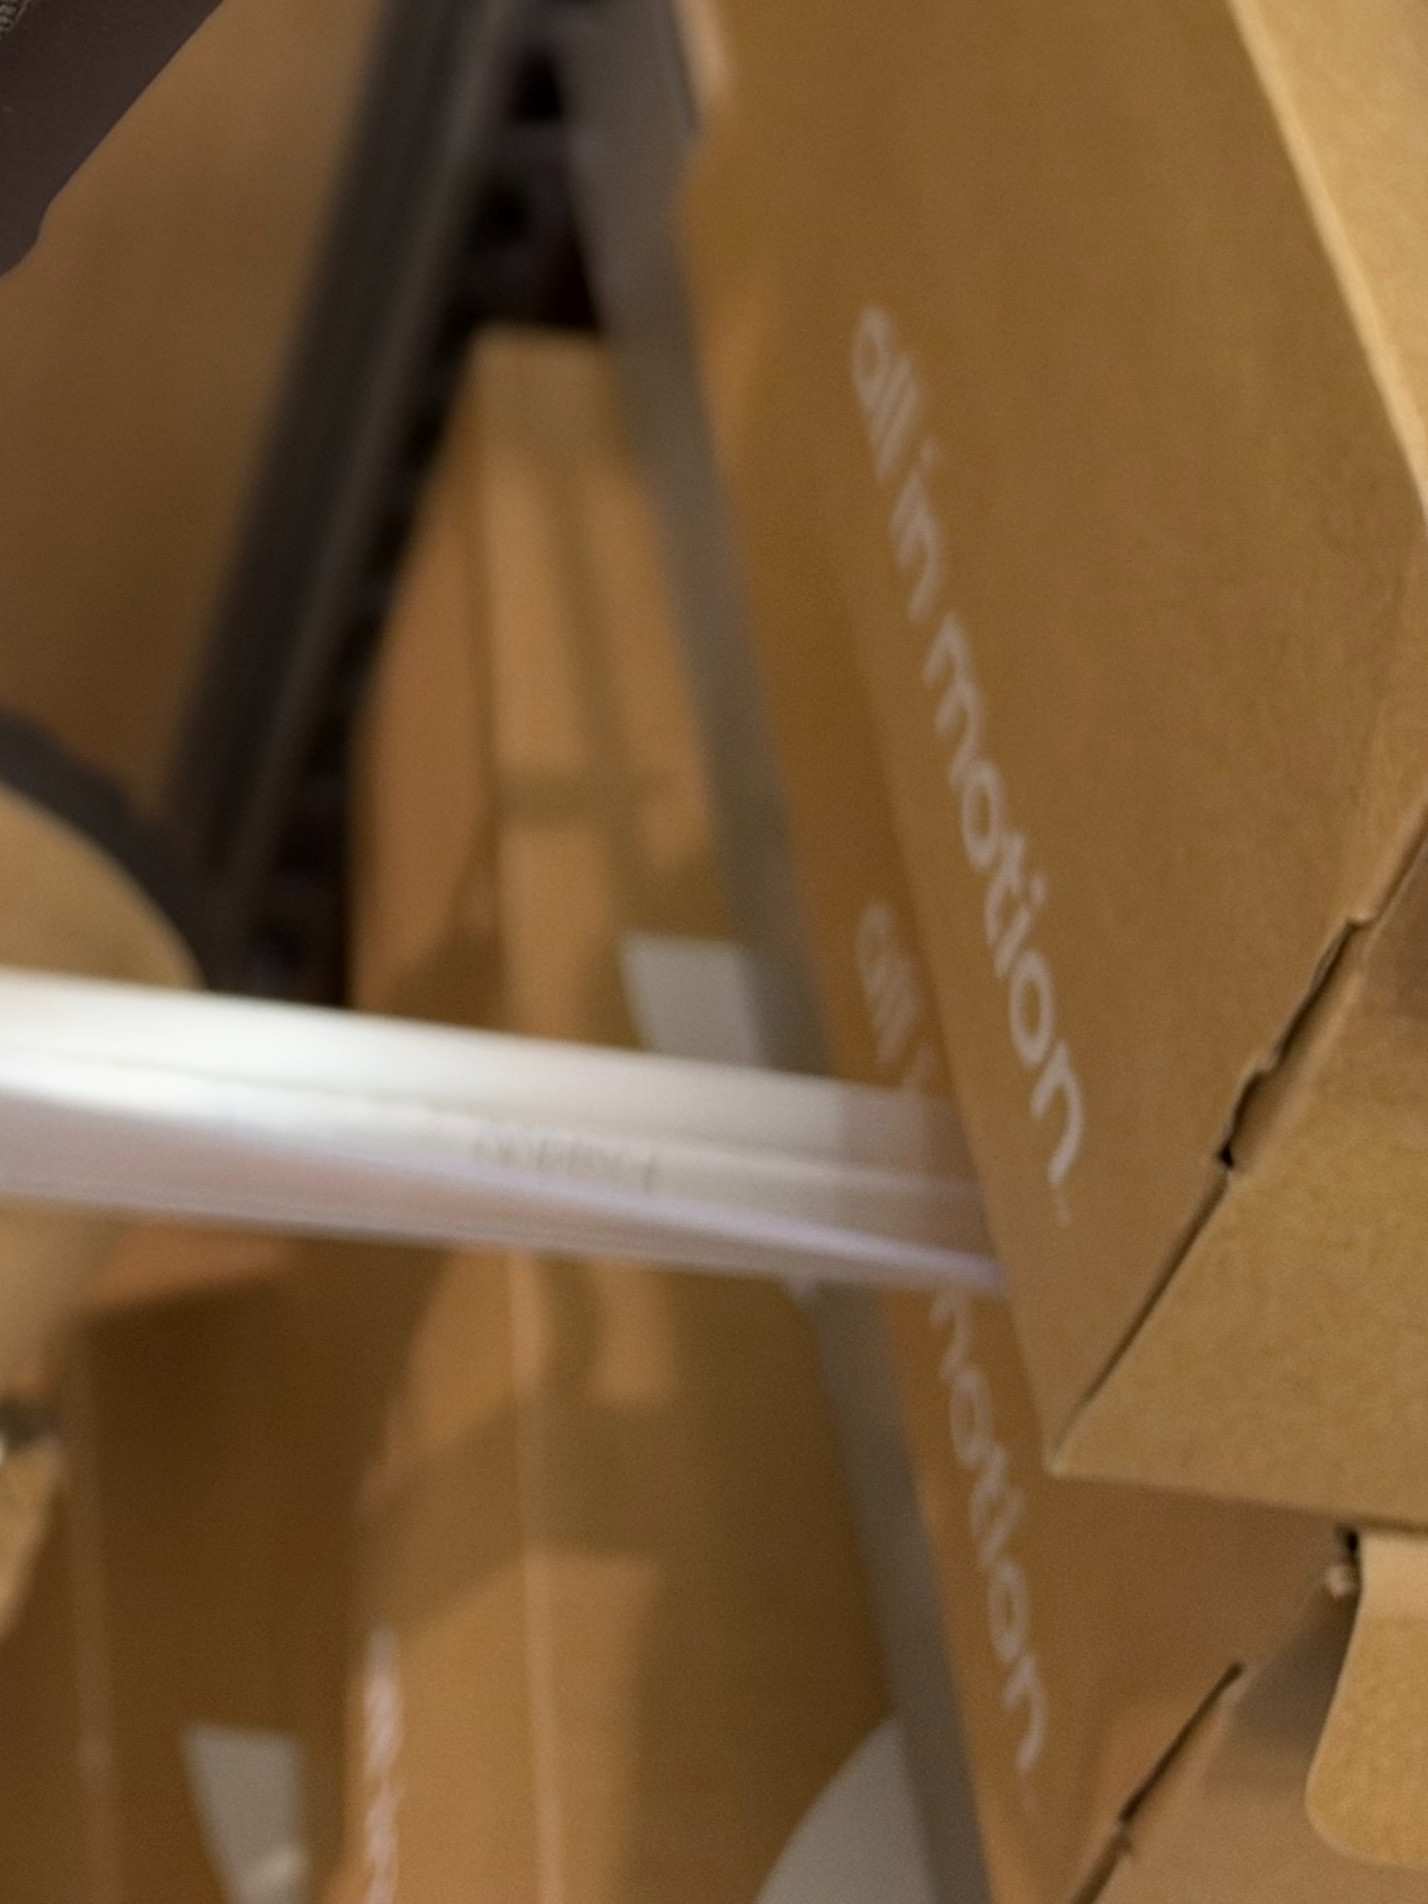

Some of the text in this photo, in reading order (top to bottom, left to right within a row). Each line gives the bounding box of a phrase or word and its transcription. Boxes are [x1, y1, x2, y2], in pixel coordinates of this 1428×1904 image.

[852, 305, 1084, 1188] all in motion
